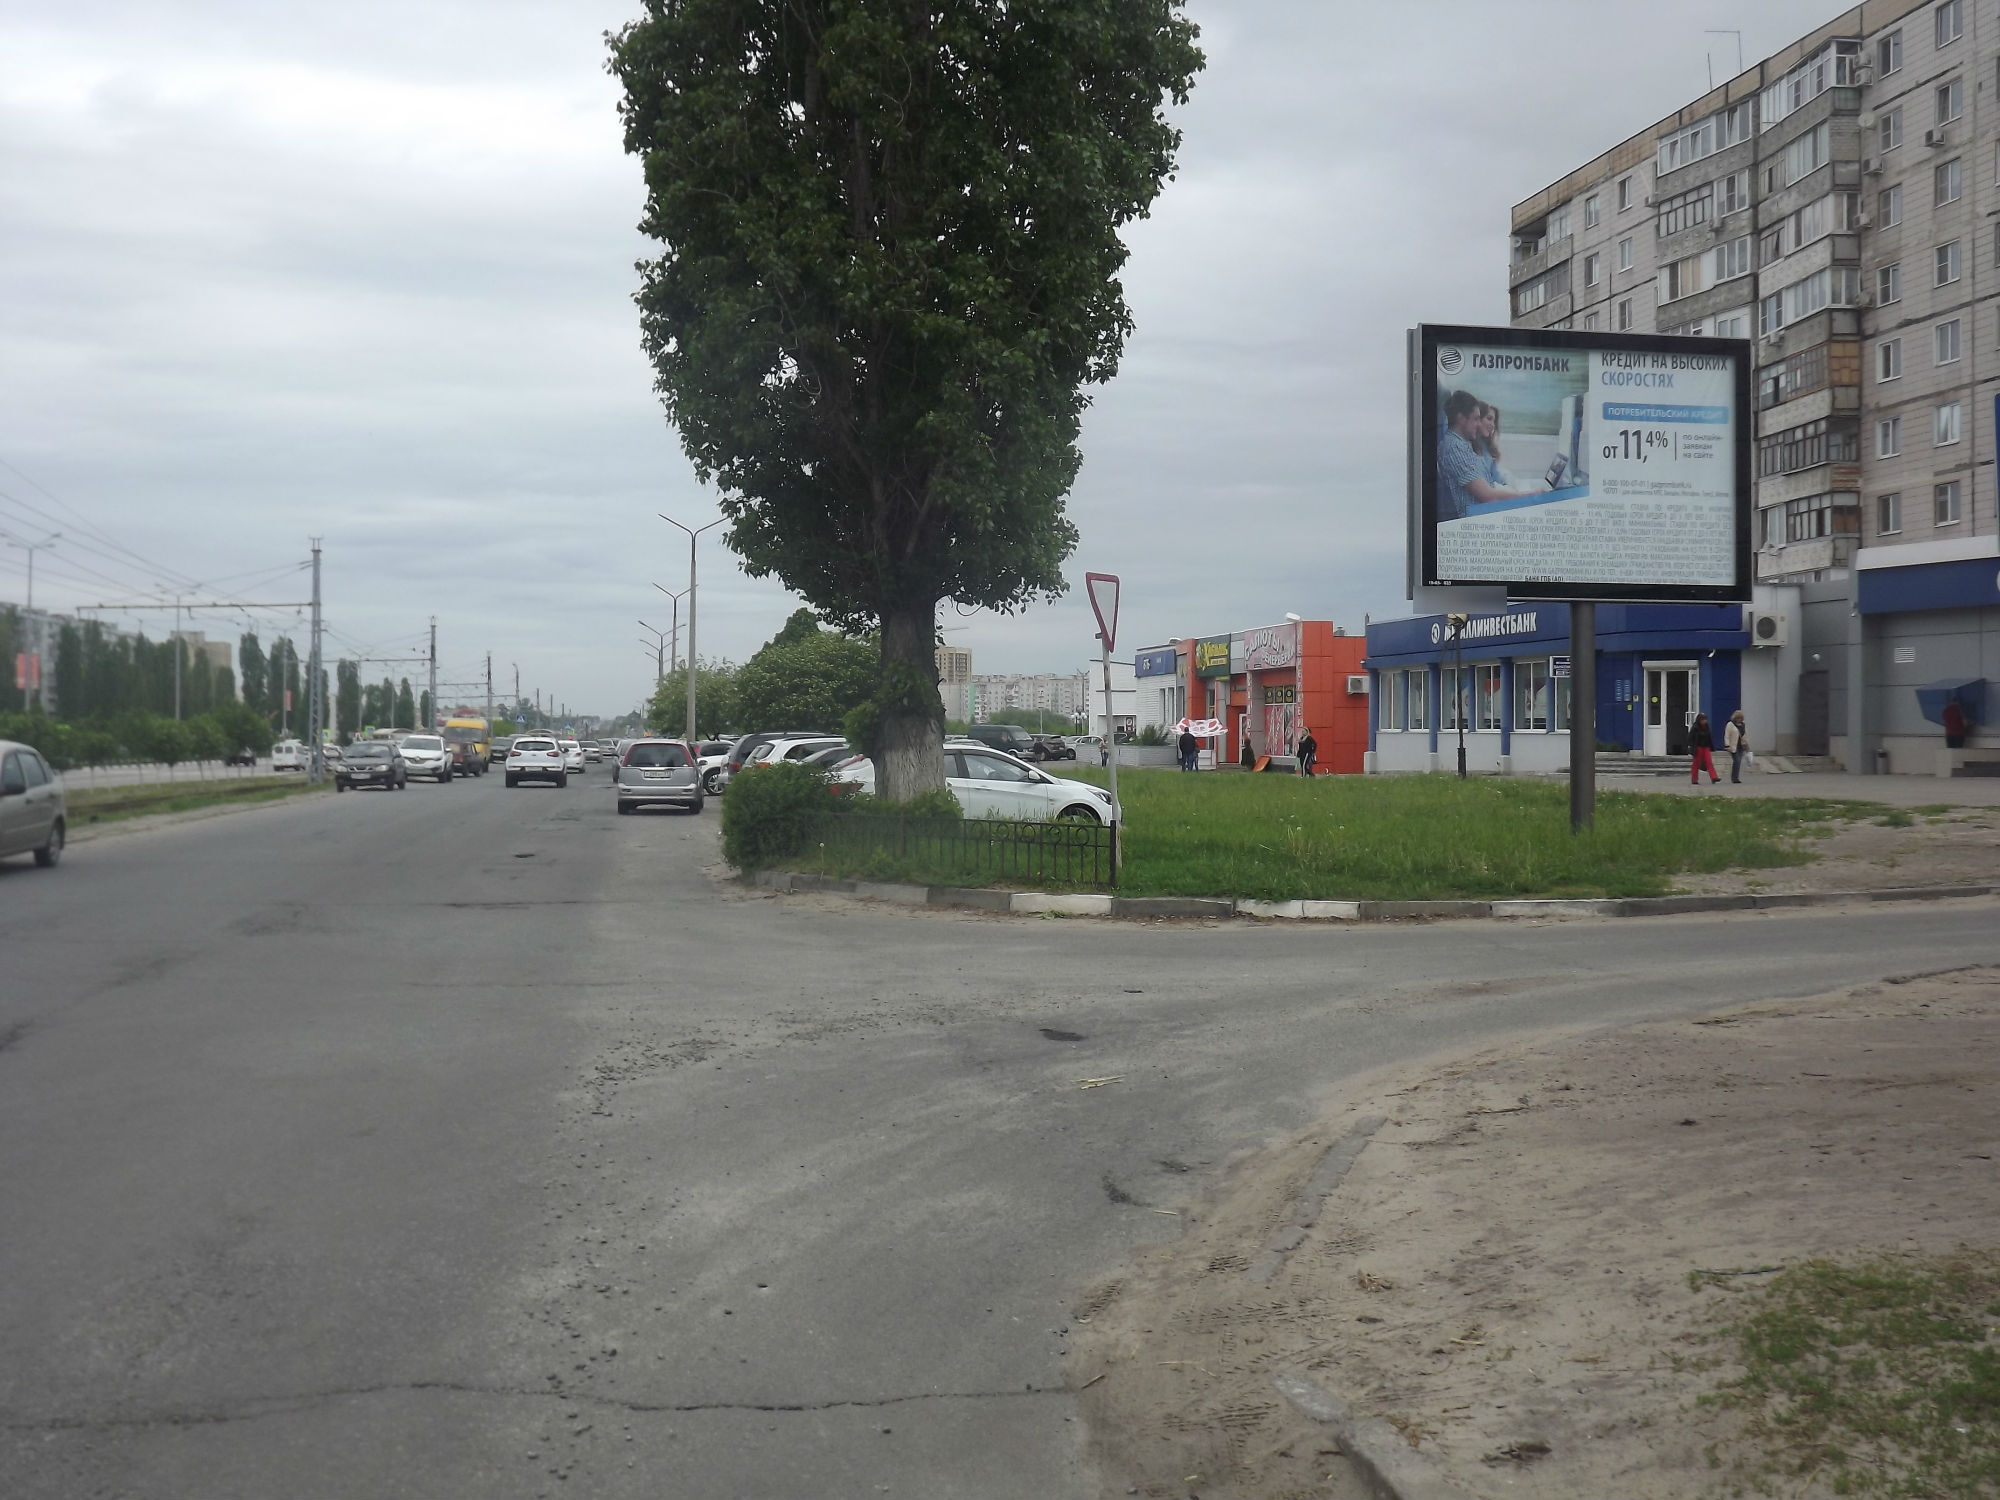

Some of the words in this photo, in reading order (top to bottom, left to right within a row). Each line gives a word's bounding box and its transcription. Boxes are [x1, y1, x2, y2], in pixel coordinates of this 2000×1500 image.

[1472, 353, 1570, 372] ГАЗПРОМБАНК
[1602, 352, 1648, 369] КРЕДИТ
[1651, 354, 1668, 369] НА
[1671, 355, 1728, 371] ВЫСОКИХ
[1601, 371, 1674, 389] СКОРОСТЯХ
[1608, 407, 1690, 419] ПОТРЕБИТЕЛЬСКИЙ
[1619, 429, 1669, 463] 11,4%
[1444, 611, 1537, 641] МАЛЛИНВЕСТБАНК
